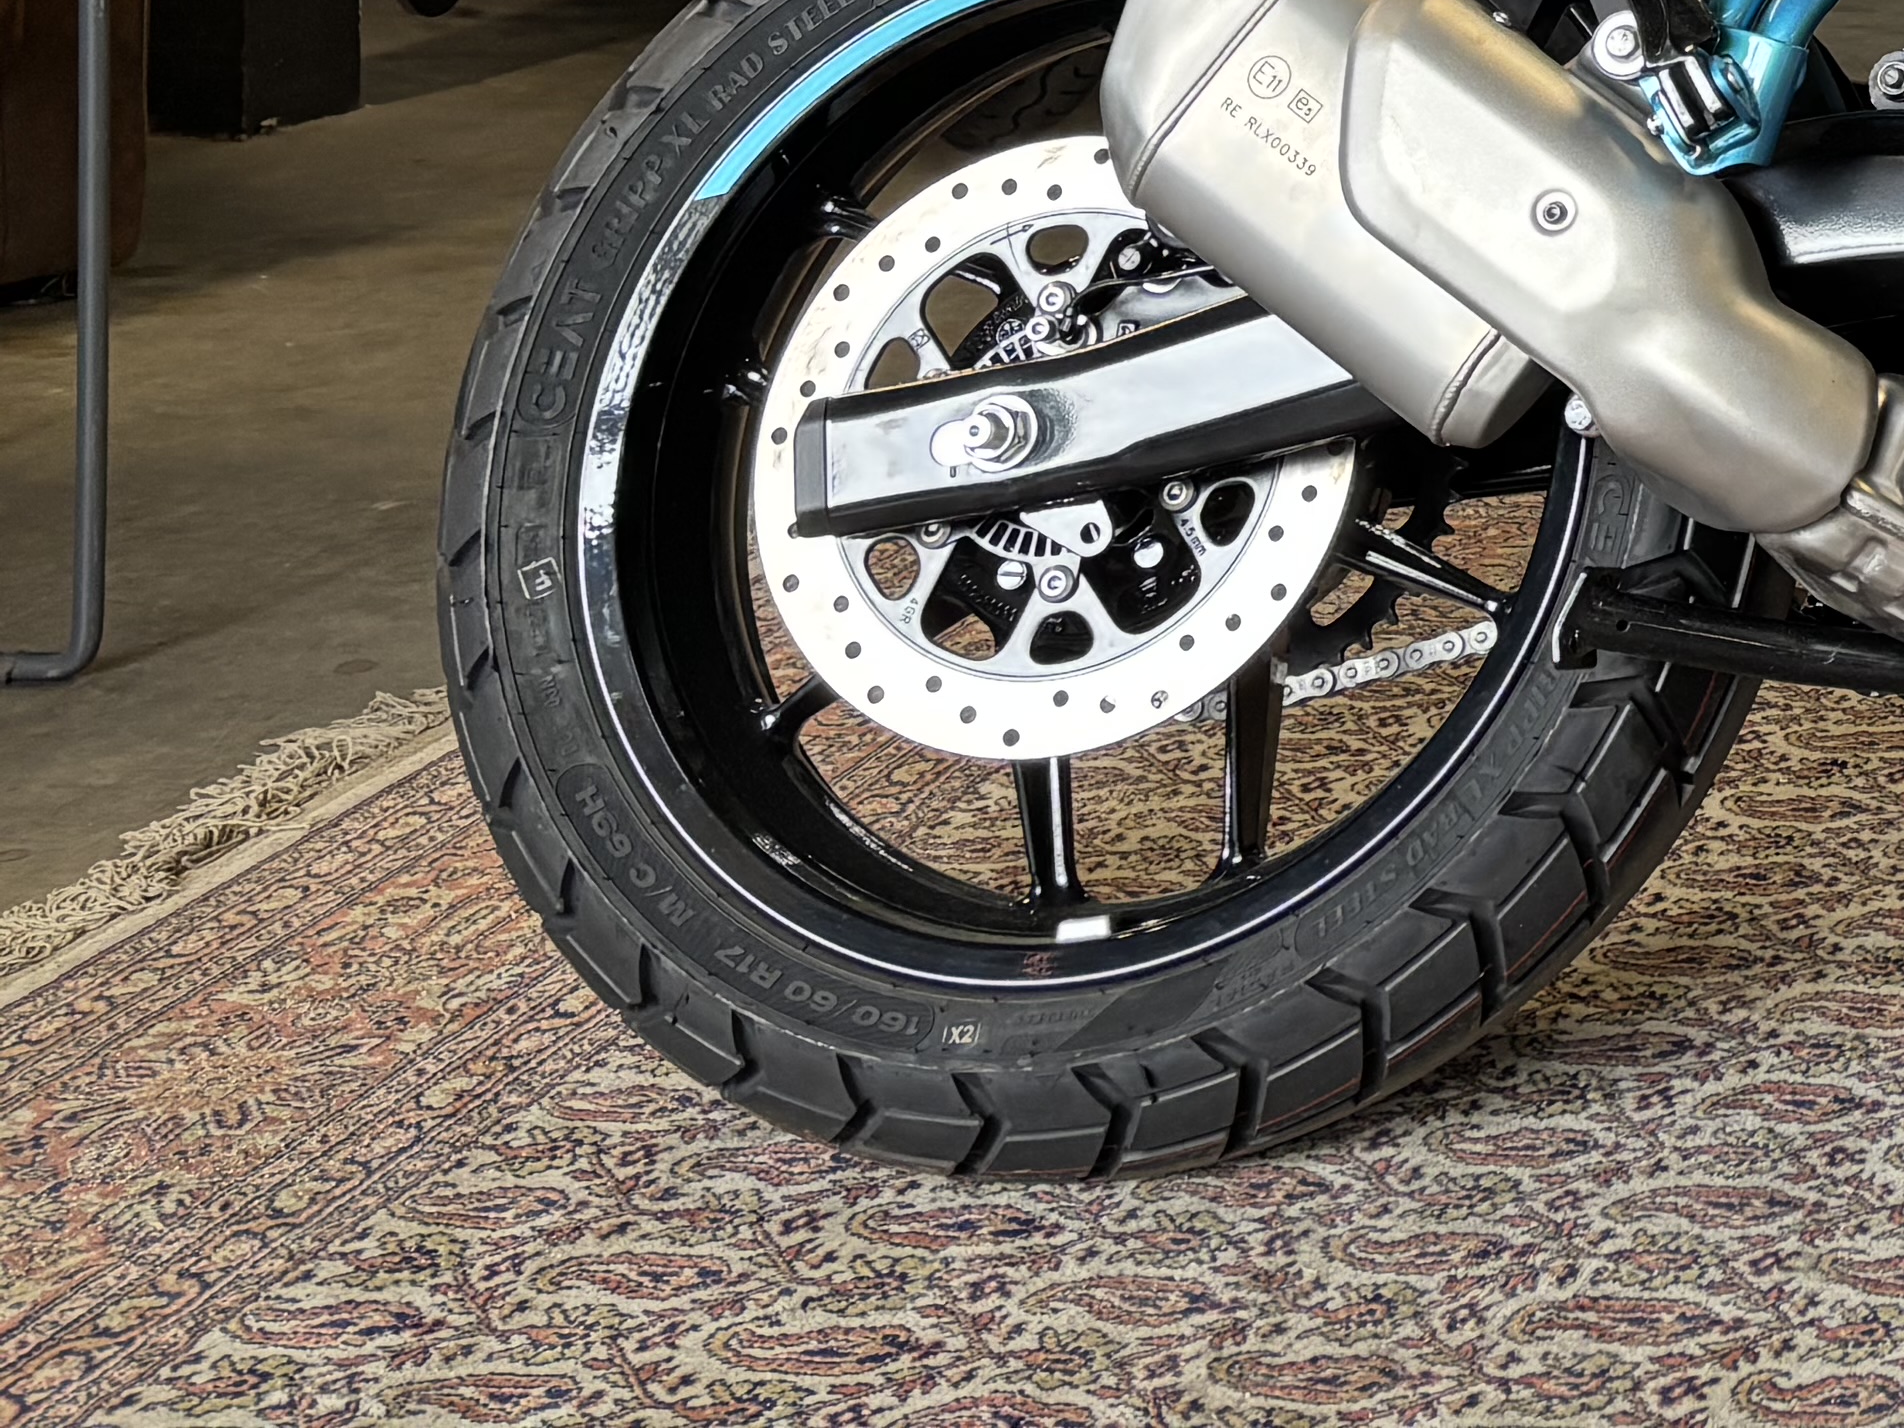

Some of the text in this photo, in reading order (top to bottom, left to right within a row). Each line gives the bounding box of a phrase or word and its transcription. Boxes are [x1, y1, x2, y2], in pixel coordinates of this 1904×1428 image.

[1220, 97, 1318, 178] RE RLX00339
[1253, 60, 1284, 93] E11
[517, 277, 604, 423] CEAT
[709, 51, 765, 112] RAD
[573, 783, 922, 1036] 160/60 R17 M/C 69H
